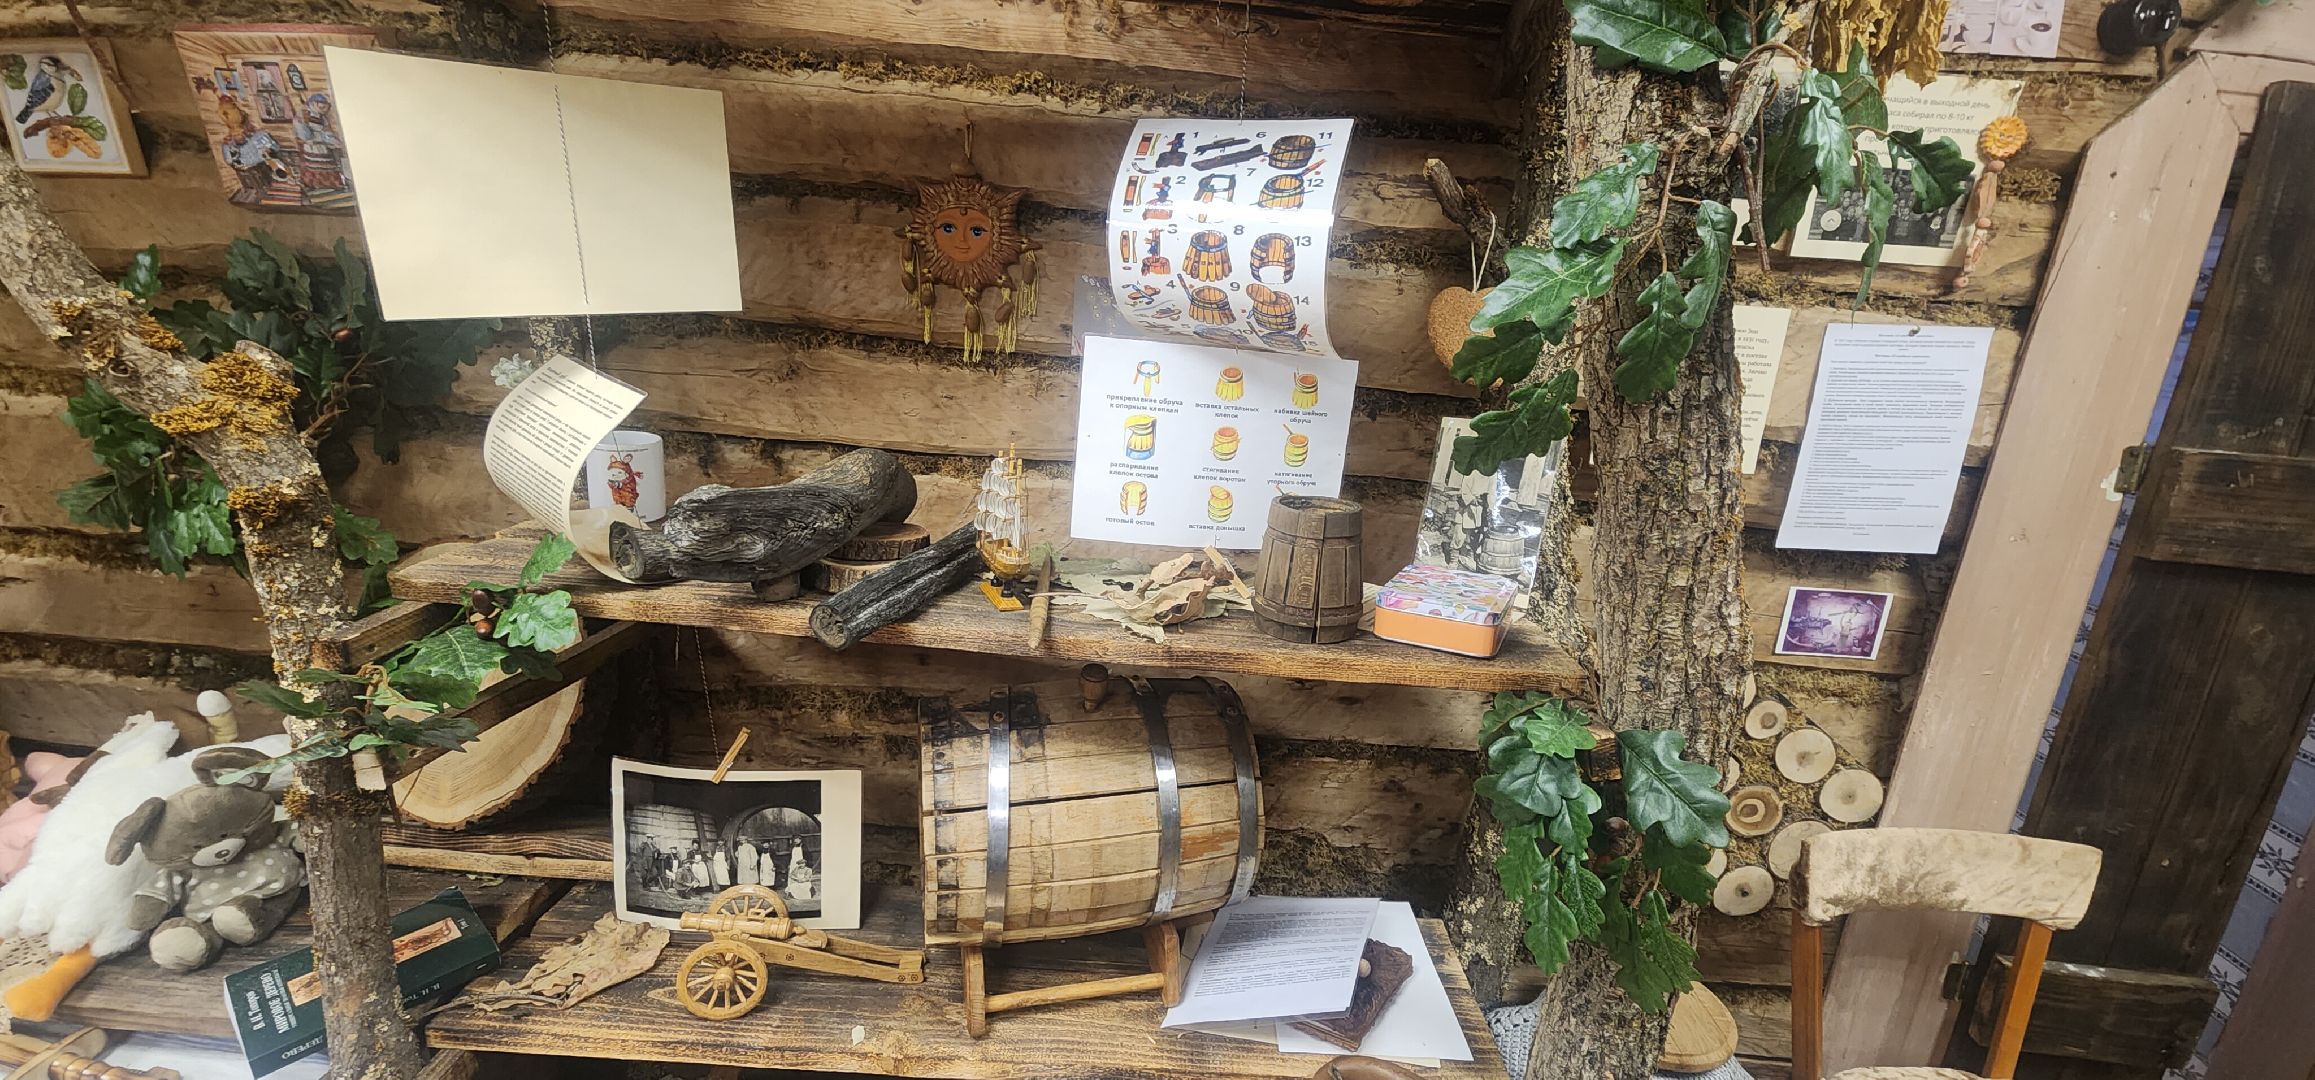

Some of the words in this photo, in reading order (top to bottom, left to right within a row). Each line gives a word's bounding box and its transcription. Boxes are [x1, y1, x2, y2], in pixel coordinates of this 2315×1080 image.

[1930, 99, 1970, 107] выходной
[1902, 110, 1934, 120] собирал
[1318, 132, 1333, 140] 11
[1246, 168, 1256, 176] 7
[1175, 176, 1186, 184] 2
[1306, 178, 1324, 187] 12
[1167, 224, 1178, 234] 3
[1233, 225, 1245, 235] 8
[1294, 236, 1312, 247] 13
[1166, 280, 1176, 289] 4
[1230, 282, 1241, 292] 9
[1294, 296, 1310, 305] 14
[1110, 462, 1159, 471] распаривание
[260, 973, 279, 999] ДЕРЕВО
[268, 998, 290, 1033] МИРОВОЕ
